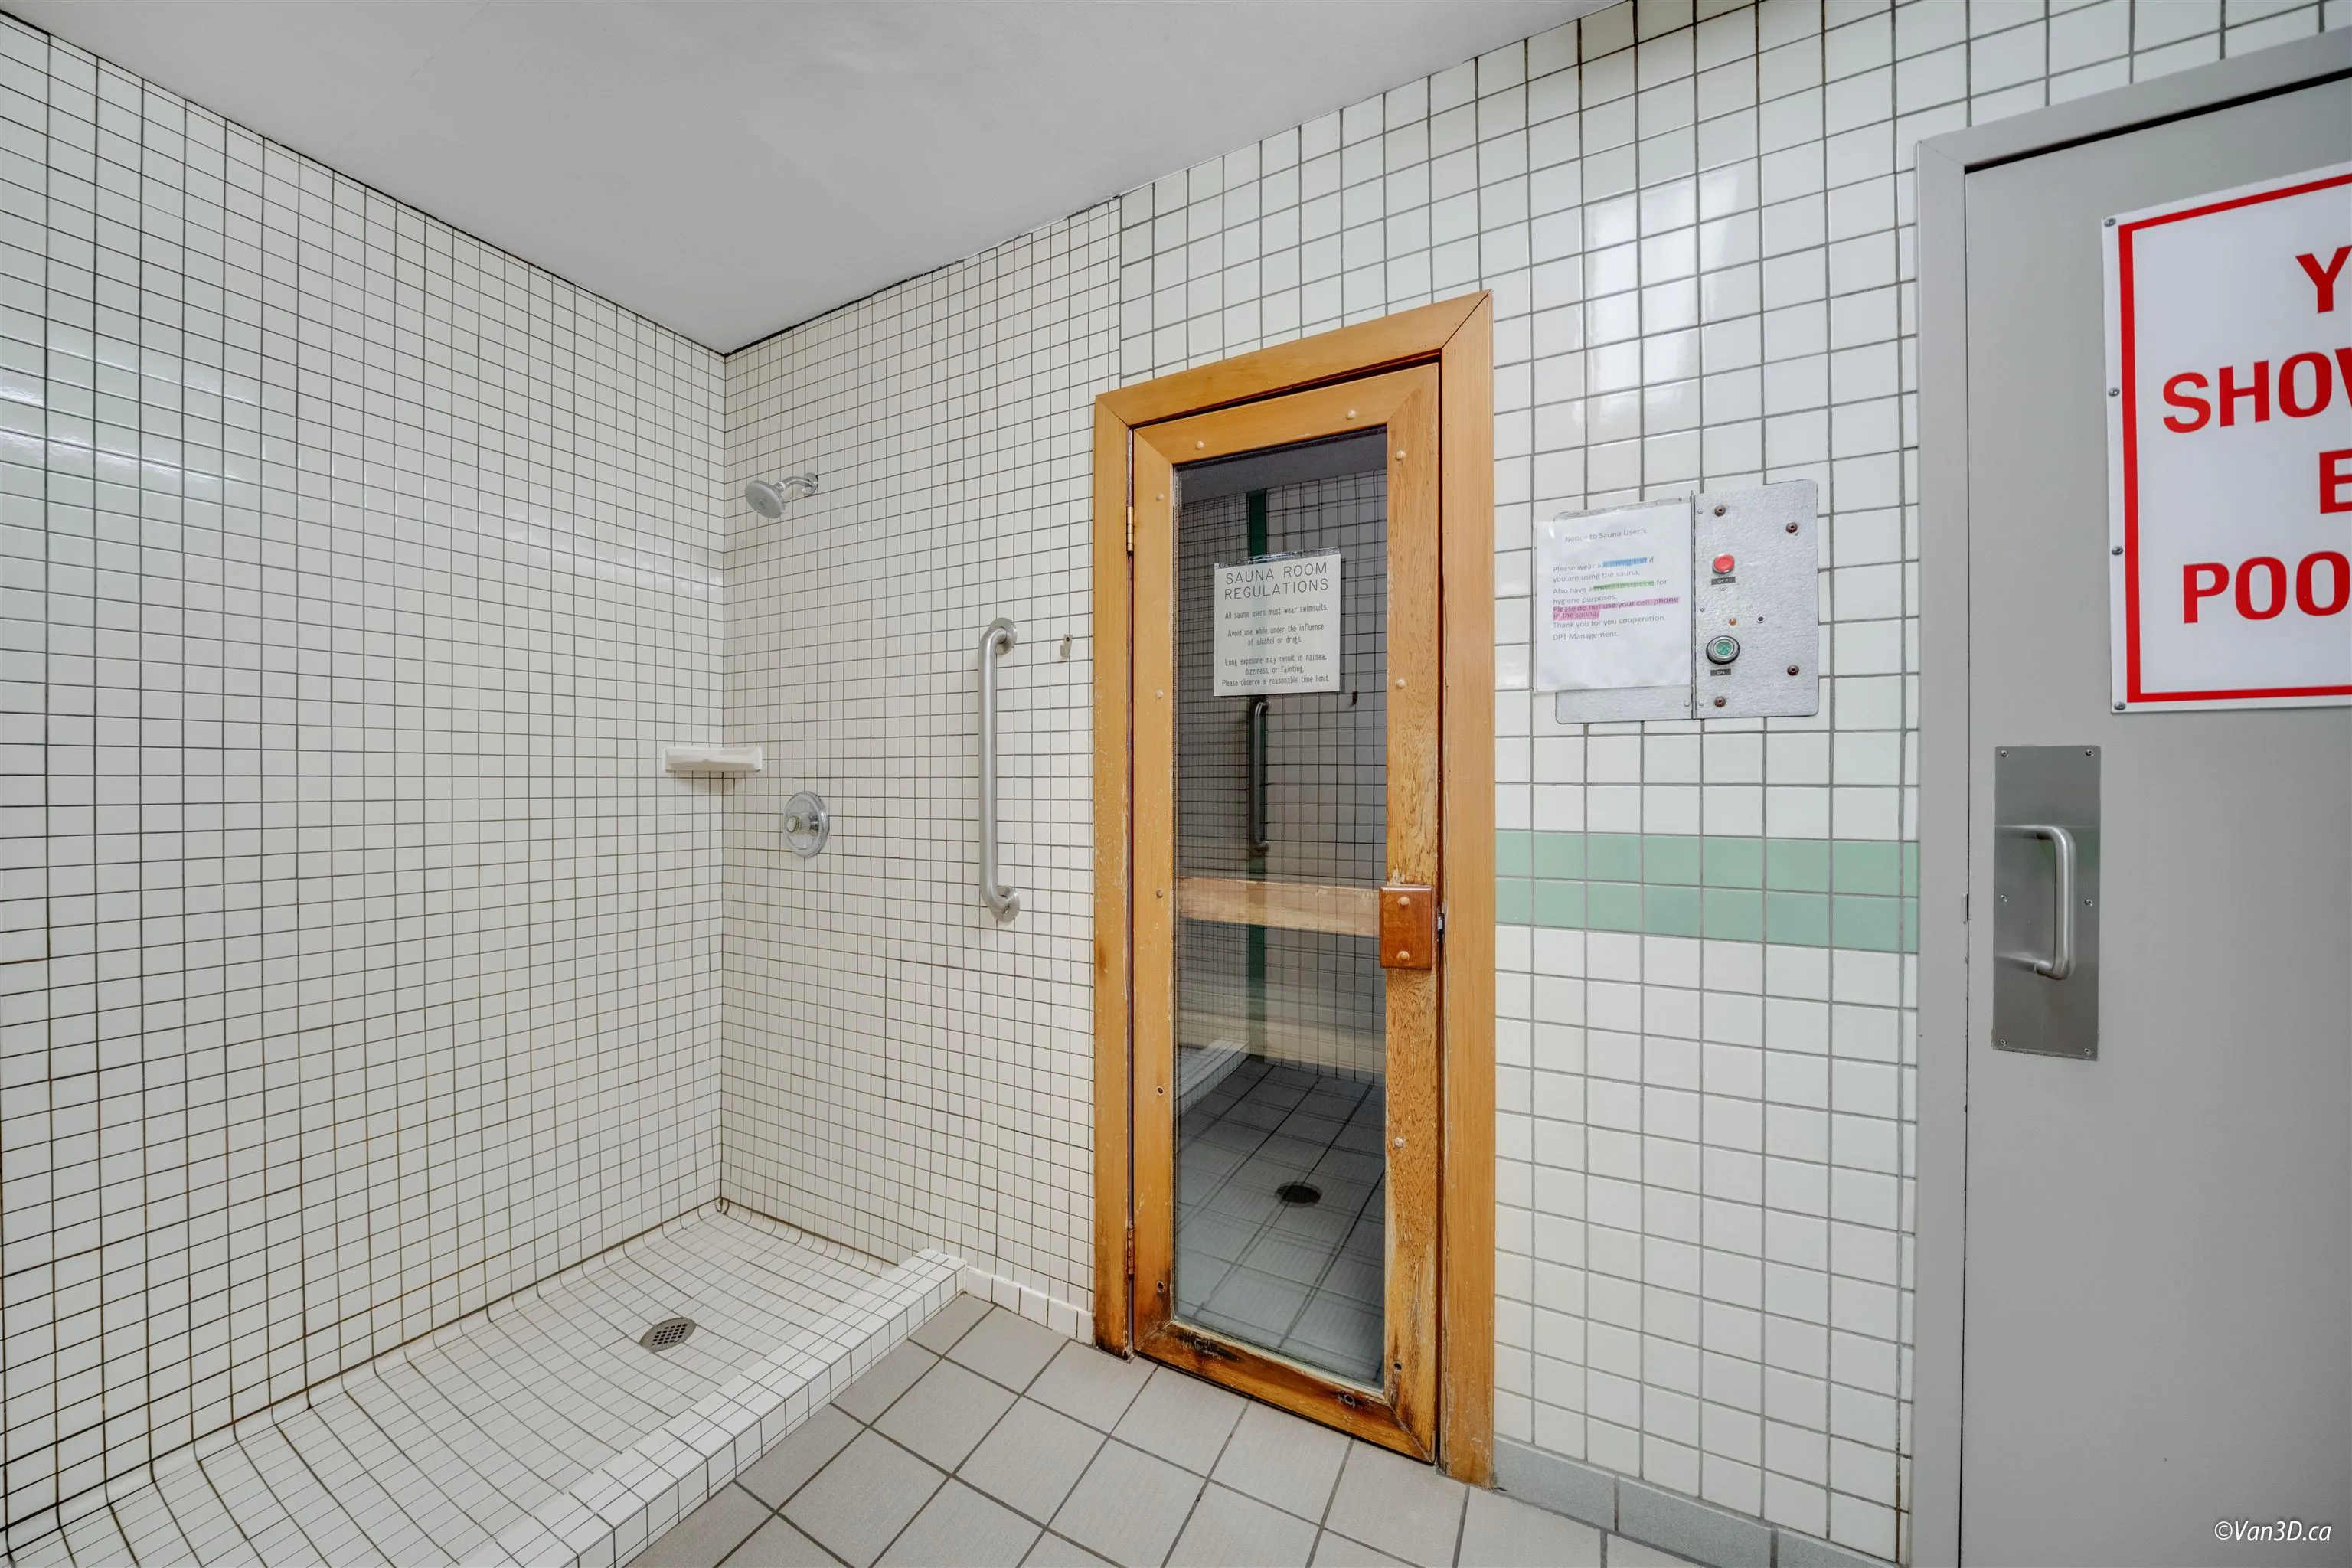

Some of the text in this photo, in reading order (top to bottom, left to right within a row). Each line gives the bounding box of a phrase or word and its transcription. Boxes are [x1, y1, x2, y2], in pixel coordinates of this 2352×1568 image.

[2162, 347, 2352, 433] SHO
[1599, 531, 1621, 539] Sauna
[1226, 562, 1326, 585] SAUNA ROOM
[1581, 572, 1599, 581] using
[1225, 579, 1328, 600] REGULATIONS
[1553, 594, 1617, 606] hygiene purposes.
[1654, 596, 1678, 606] phone
[1300, 603, 1328, 612] swimsuits.
[1591, 618, 1600, 626] for
[1603, 617, 1616, 626] you
[1619, 615, 1666, 625] cooperation.
[1288, 624, 1296, 632] the
[1257, 637, 1274, 645] alcohol
[1286, 635, 1302, 644] drugs.
[1569, 631, 1619, 640] Management.
[1269, 676, 1298, 684] reasonable
